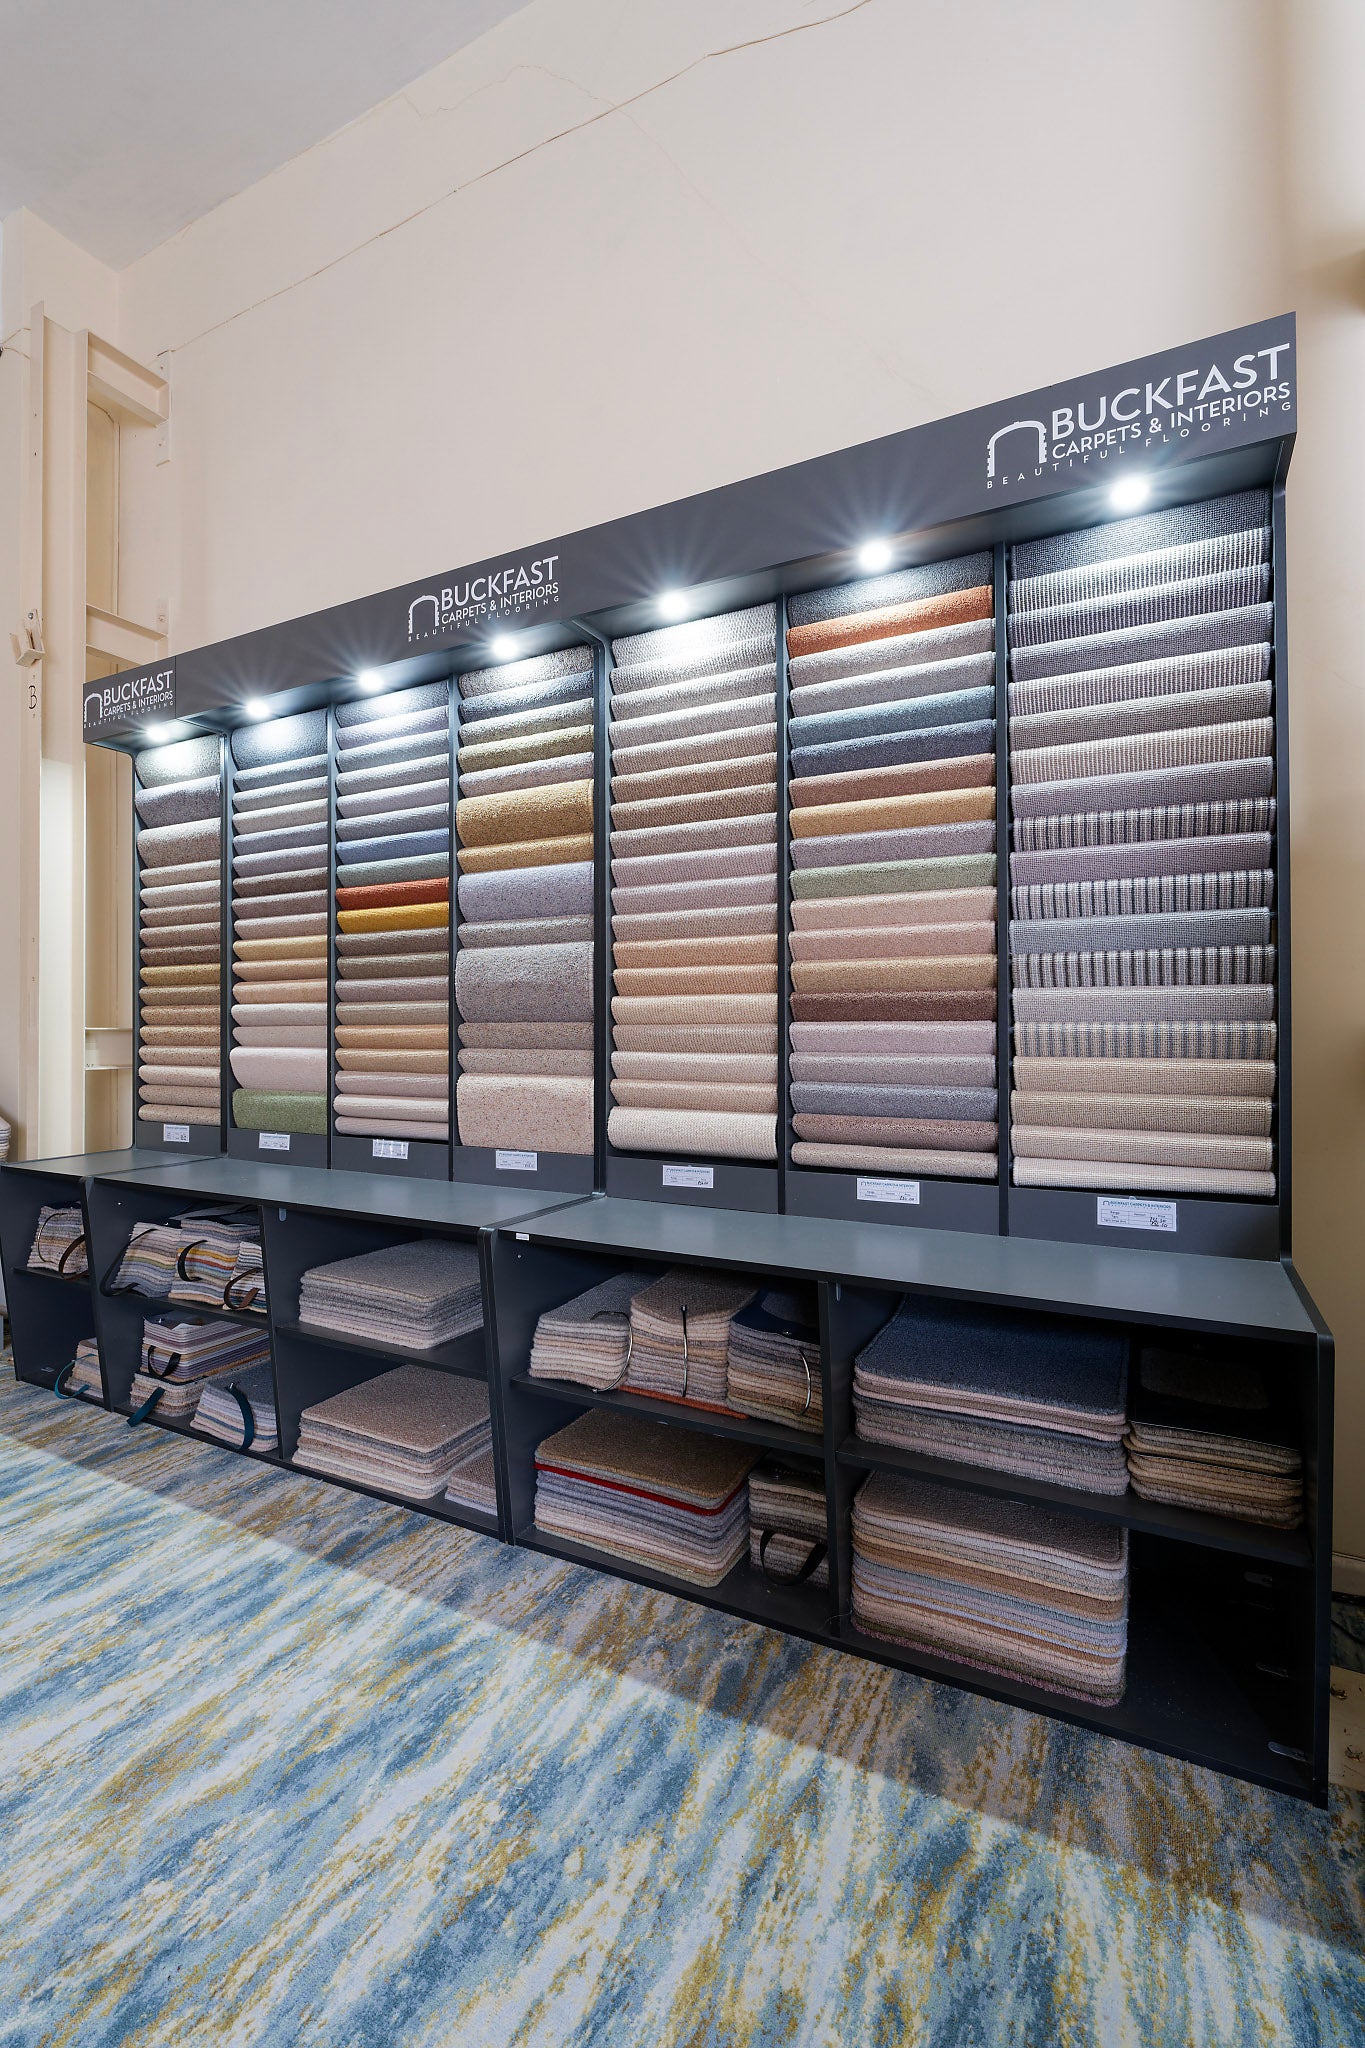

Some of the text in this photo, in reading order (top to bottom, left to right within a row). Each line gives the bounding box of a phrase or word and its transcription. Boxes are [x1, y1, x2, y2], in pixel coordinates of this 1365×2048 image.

[1052, 342, 1290, 440] BUCKFAST
[987, 401, 1291, 489] BEAUTIFUL FLOORING
[1052, 382, 1290, 459] CARPETS & INTERIORS
[441, 555, 559, 611] BUCKFAST
[441, 582, 559, 624] CARPETS & INTERIORS
[408, 596, 559, 642] BEAUTIFUL FLOORING
[103, 670, 173, 706] BUCKFAST
[103, 702, 131, 717] CARPETS
[138, 690, 173, 708] INTERIORS
